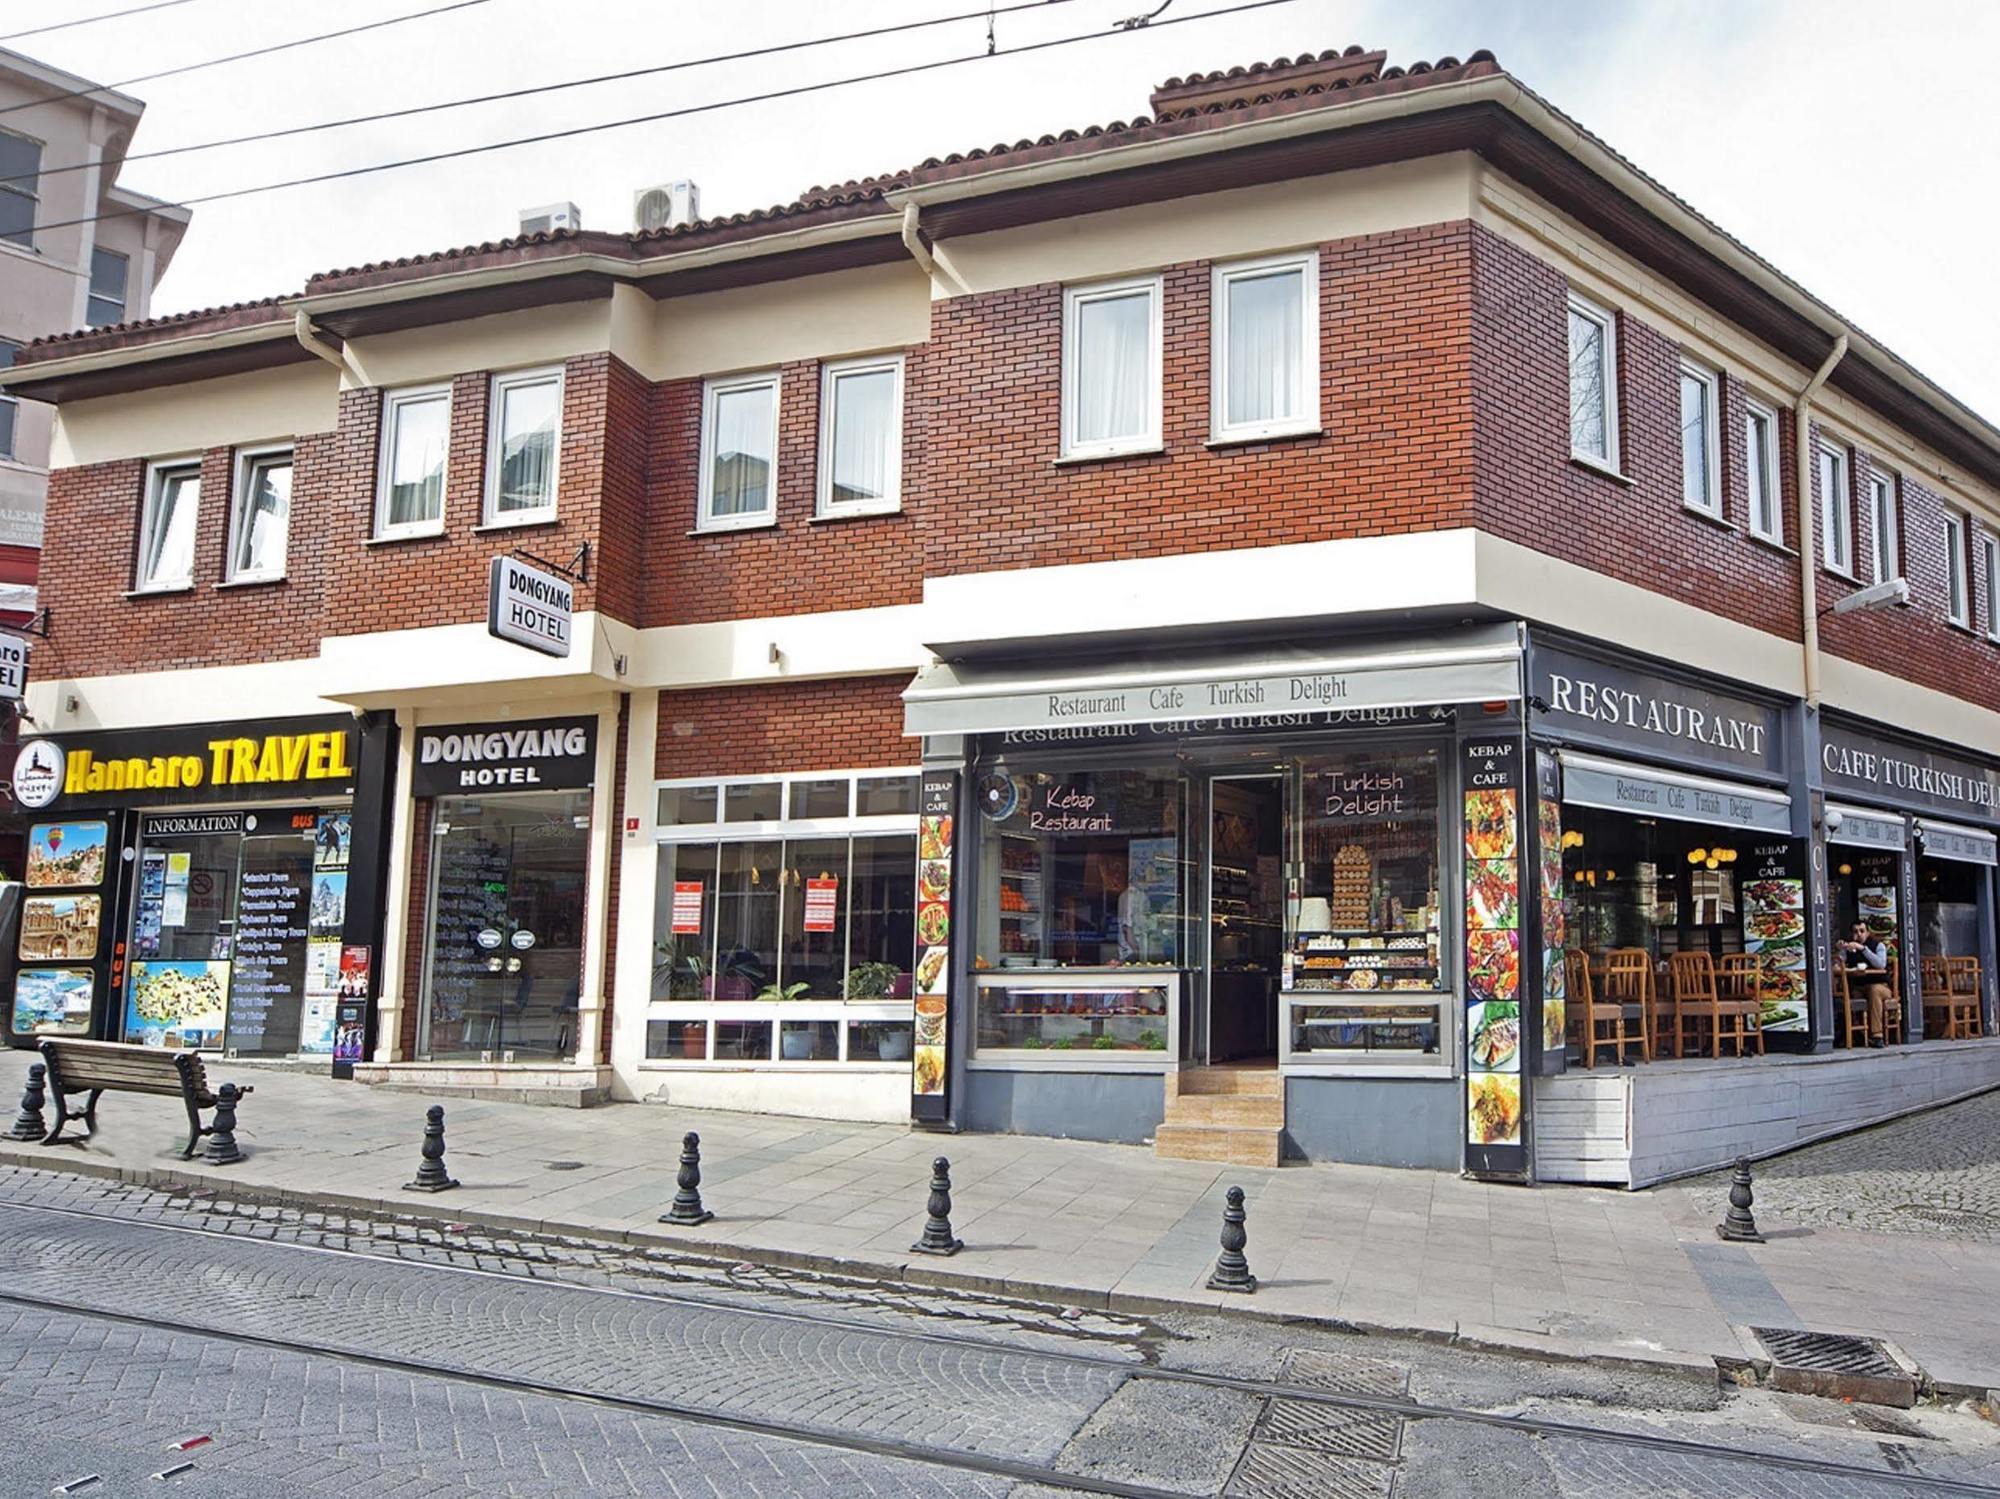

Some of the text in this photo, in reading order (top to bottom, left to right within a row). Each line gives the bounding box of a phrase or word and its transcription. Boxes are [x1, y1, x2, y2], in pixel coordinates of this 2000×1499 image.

[509, 569, 570, 612] DONGYANG
[512, 604, 565, 641] HOTEL
[0, 647, 20, 662] ro
[1049, 676, 1348, 717] Restaurant Cafe Turkish Delight
[1549, 673, 1765, 755] RESTAURANT
[421, 728, 587, 764] DONGYANG
[1469, 744, 1512, 758] KEBAP
[64, 750, 203, 794] Hannaro
[208, 731, 353, 785] TRAVEL
[1484, 760, 1496, 770] &
[1823, 743, 1878, 783] CAFE
[1881, 757, 1964, 800] TURKISH
[460, 767, 541, 787] HOTEL
[1325, 771, 1404, 793] Turkish
[1473, 772, 1508, 785] CAFE
[926, 802, 949, 812] CAFE
[1046, 785, 1095, 811] Kebap
[1325, 794, 1404, 816] Delight
[148, 816, 239, 833] INFORMATION
[291, 814, 314, 828] BUS
[1030, 811, 1113, 832] Restaurant
[1758, 866, 1785, 877] CAFE
[1813, 846, 1826, 971] CAFE
[1904, 861, 1918, 996] RESTAURANT
[111, 942, 125, 988] BUS
